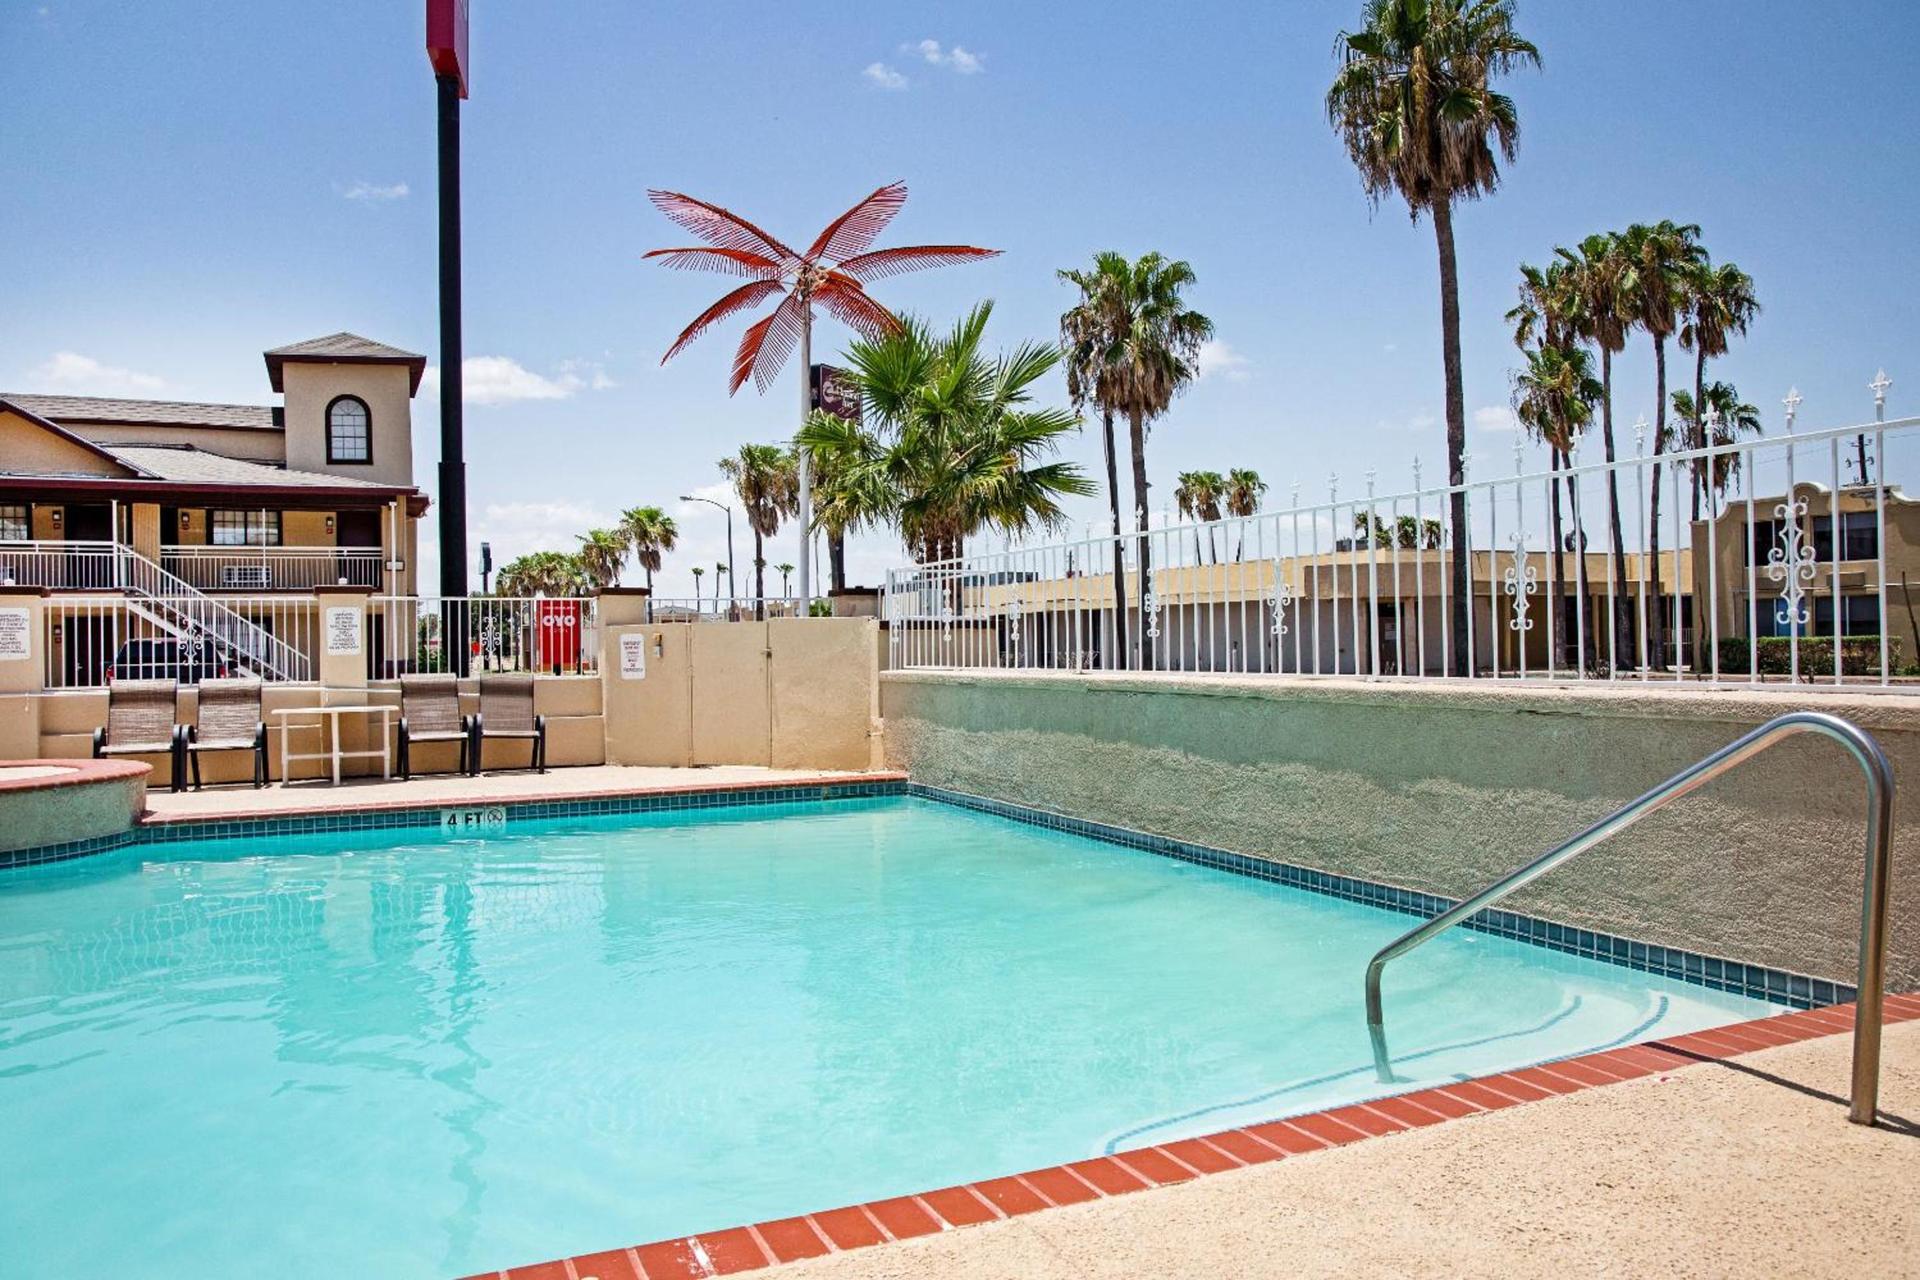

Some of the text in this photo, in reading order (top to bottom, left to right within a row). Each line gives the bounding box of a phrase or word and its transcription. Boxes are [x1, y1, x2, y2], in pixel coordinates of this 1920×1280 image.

[542, 614, 576, 627] OYO
[447, 811, 483, 825] 4 FT
